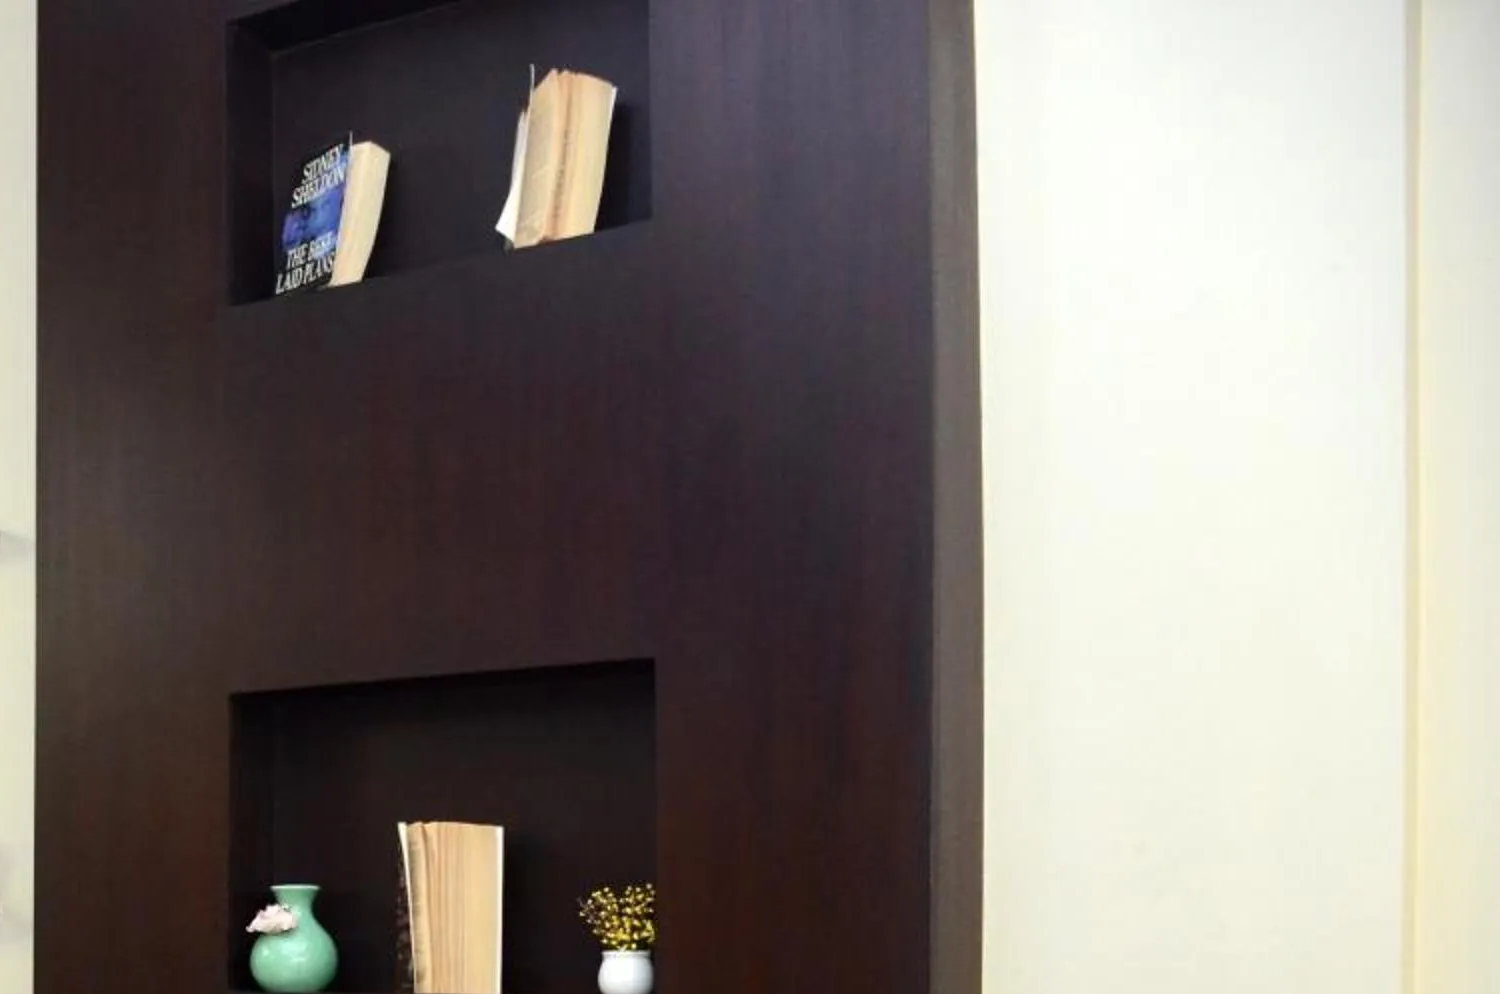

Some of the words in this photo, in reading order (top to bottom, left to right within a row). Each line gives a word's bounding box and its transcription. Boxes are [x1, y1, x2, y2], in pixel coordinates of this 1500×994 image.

[302, 143, 344, 183] SIDNEY
[290, 165, 344, 208] SHELDON
[286, 243, 308, 270] THE
[275, 267, 303, 295] LAID
